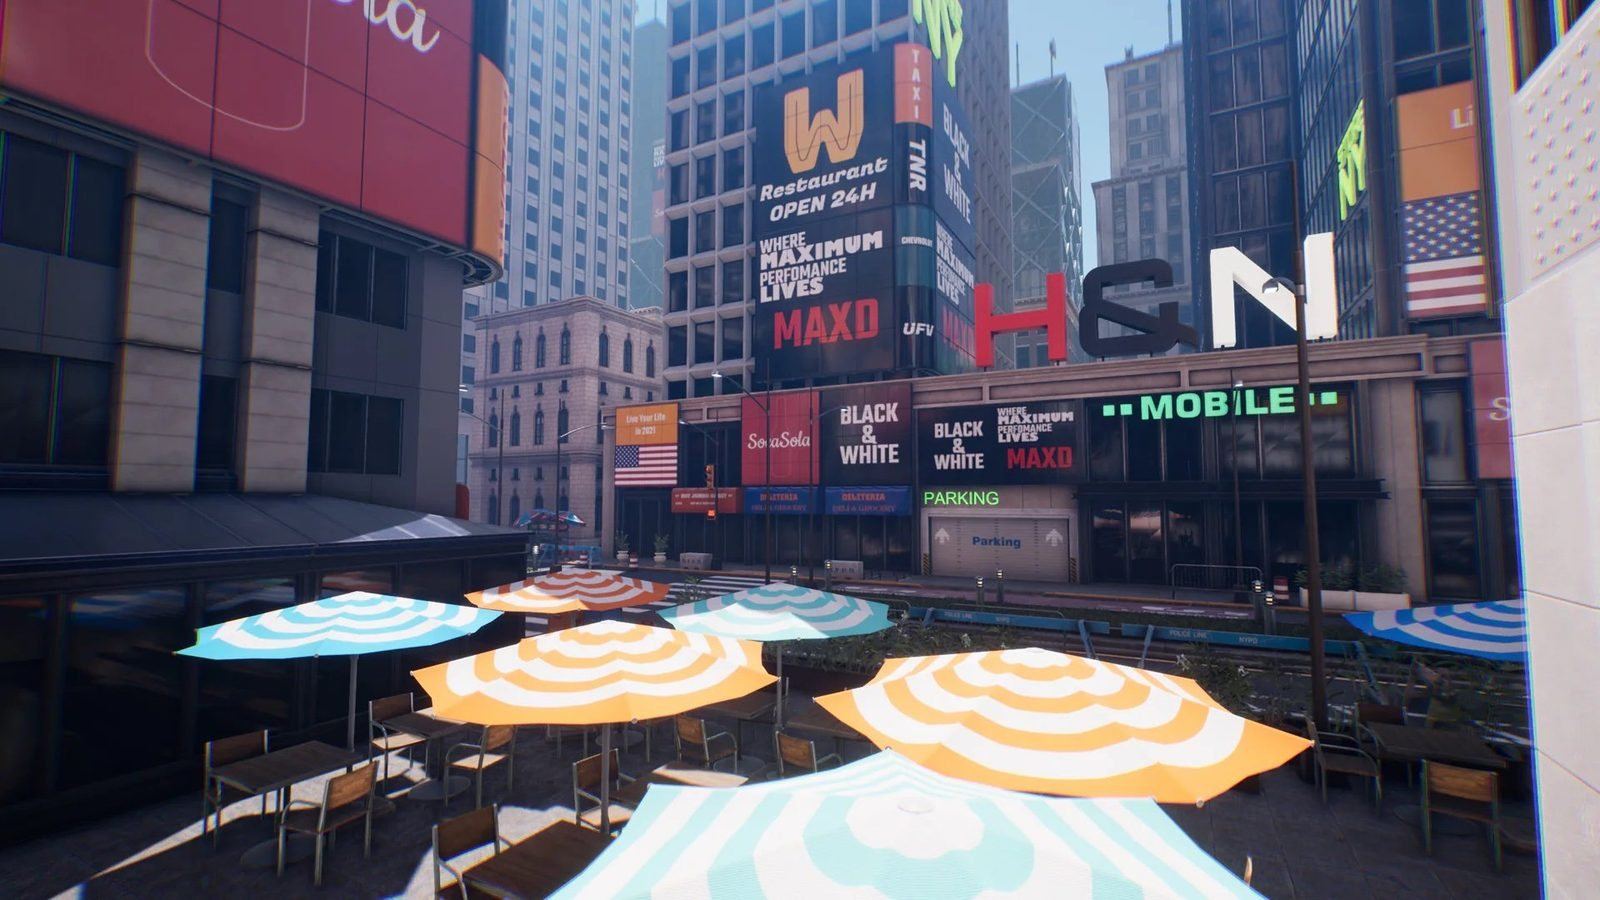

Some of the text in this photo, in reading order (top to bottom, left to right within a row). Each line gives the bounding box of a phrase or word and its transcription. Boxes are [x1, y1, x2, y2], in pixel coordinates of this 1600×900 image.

[911, 48, 921, 119] TAXI
[784, 68, 864, 174] W
[943, 102, 970, 170] BLACK
[908, 138, 926, 192] TNR
[760, 157, 889, 201] Restaurant
[769, 182, 877, 222] OPEN 24H
[943, 163, 971, 225] WHITE
[760, 231, 806, 254] WHERE
[760, 230, 883, 271] MAXIMUM
[760, 257, 847, 287] PERFOMANCE
[760, 276, 824, 304] LIVES
[773, 298, 879, 349] MAXD
[903, 322, 934, 337] UFV
[840, 402, 899, 425] BLACK
[997, 406, 1027, 417] WHERE
[1141, 386, 1296, 421] MOBILE
[997, 411, 1074, 425] MAXIMUM
[997, 423, 1053, 434] PERFOMANCE
[862, 424, 877, 444] &
[934, 421, 984, 439] BLACK
[997, 432, 1039, 443] LIVES
[840, 443, 900, 465] WHITE
[952, 438, 965, 453] &
[934, 453, 984, 470] WHITE
[1007, 446, 1073, 469] MAXD
[924, 491, 999, 505] PARKING
[972, 536, 1021, 550] Parking
[1169, 629, 1190, 640] POLICE
